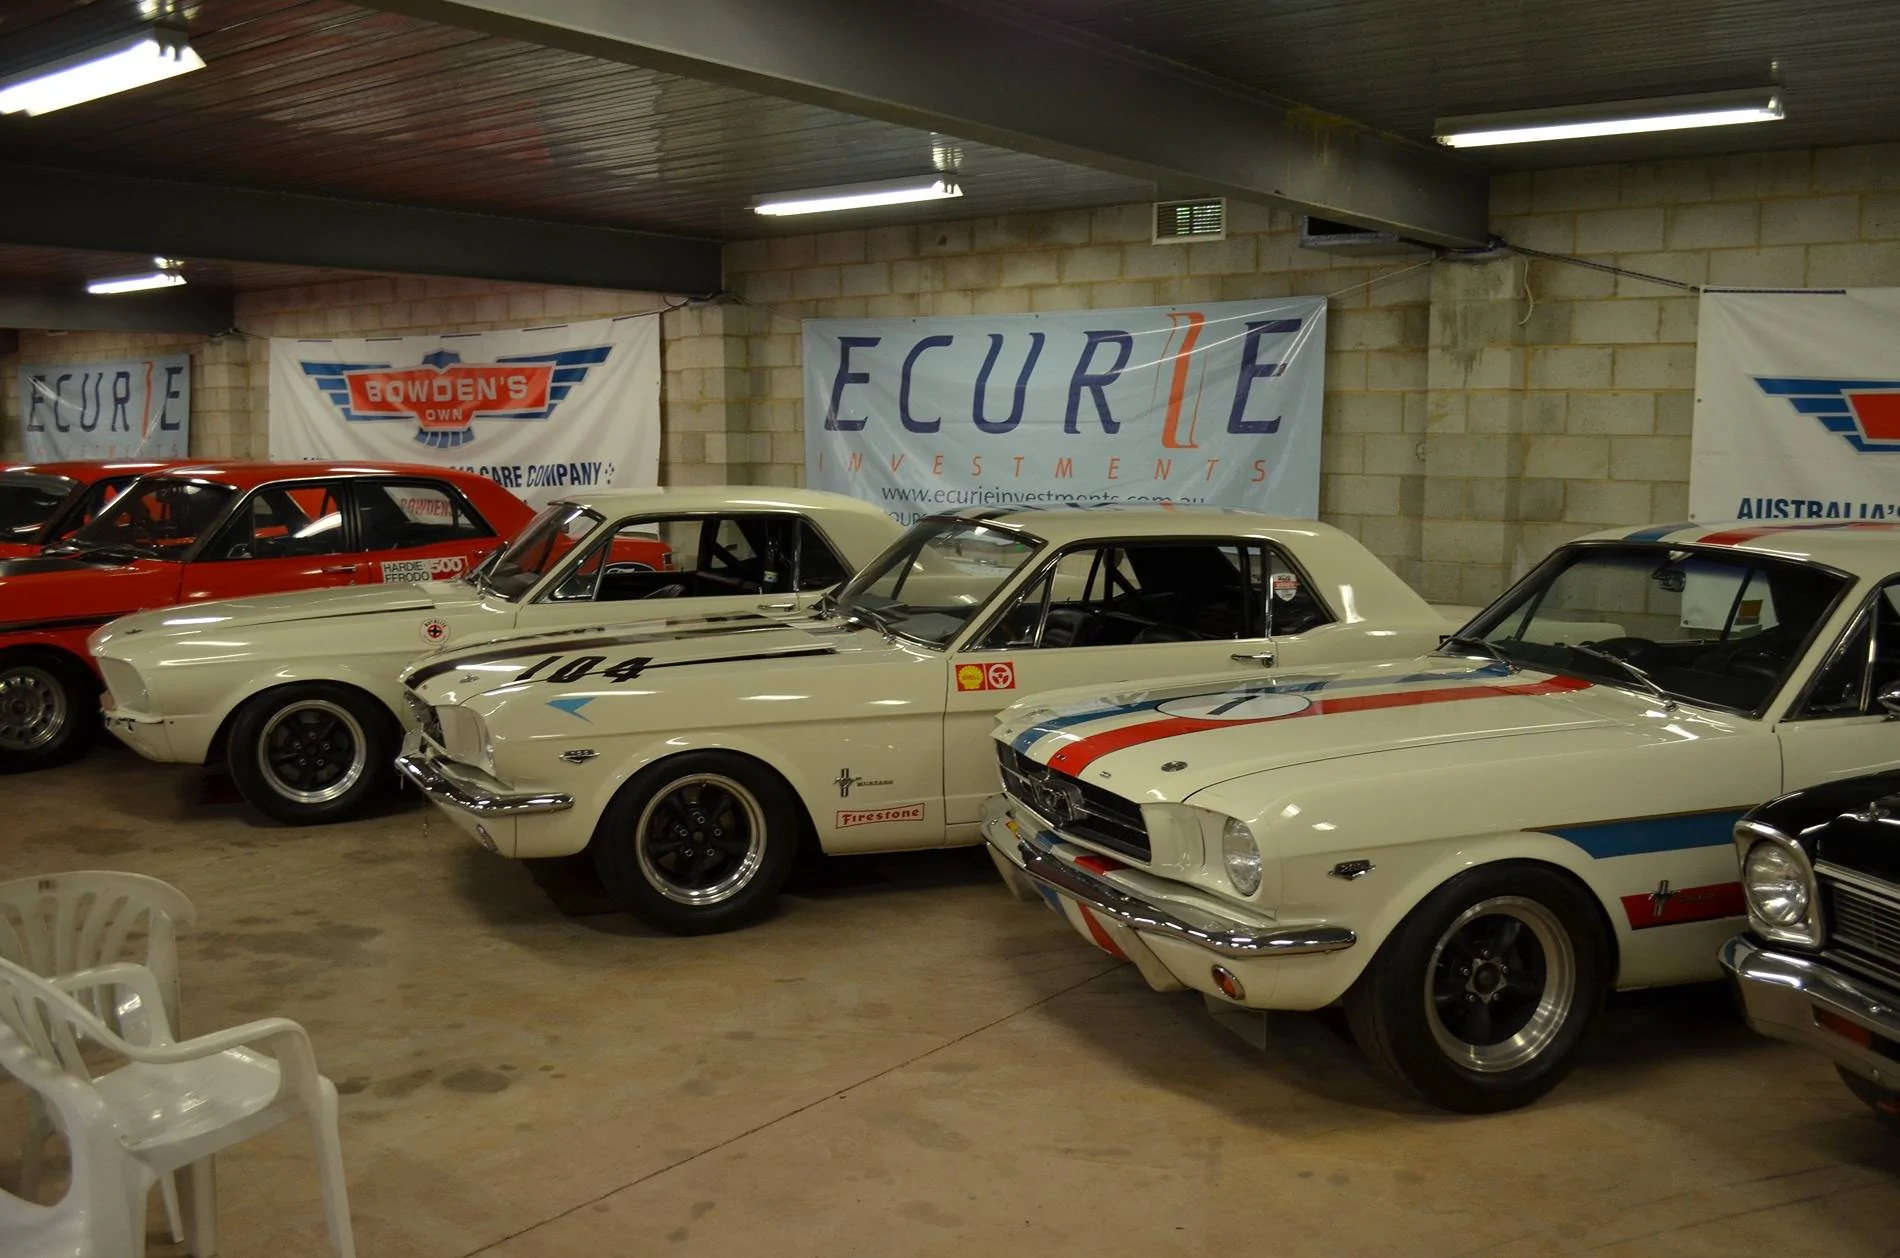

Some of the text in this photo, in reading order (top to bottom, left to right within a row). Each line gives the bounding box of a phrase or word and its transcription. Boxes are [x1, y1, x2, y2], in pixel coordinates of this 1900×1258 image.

[365, 375, 528, 402] BOWDEN'S
[824, 311, 1302, 449] ECURIE
[27, 362, 184, 440] ECURIE
[425, 408, 463, 421] OWN
[526, 462, 602, 488] COMPANY
[819, 452, 1266, 483] INVESTMENTS
[1737, 497, 1900, 519] AUSTRALIA'
[384, 571, 430, 583] FERODO
[430, 558, 463, 573] 500
[513, 655, 653, 683] 104
[842, 808, 920, 825] Firestone
